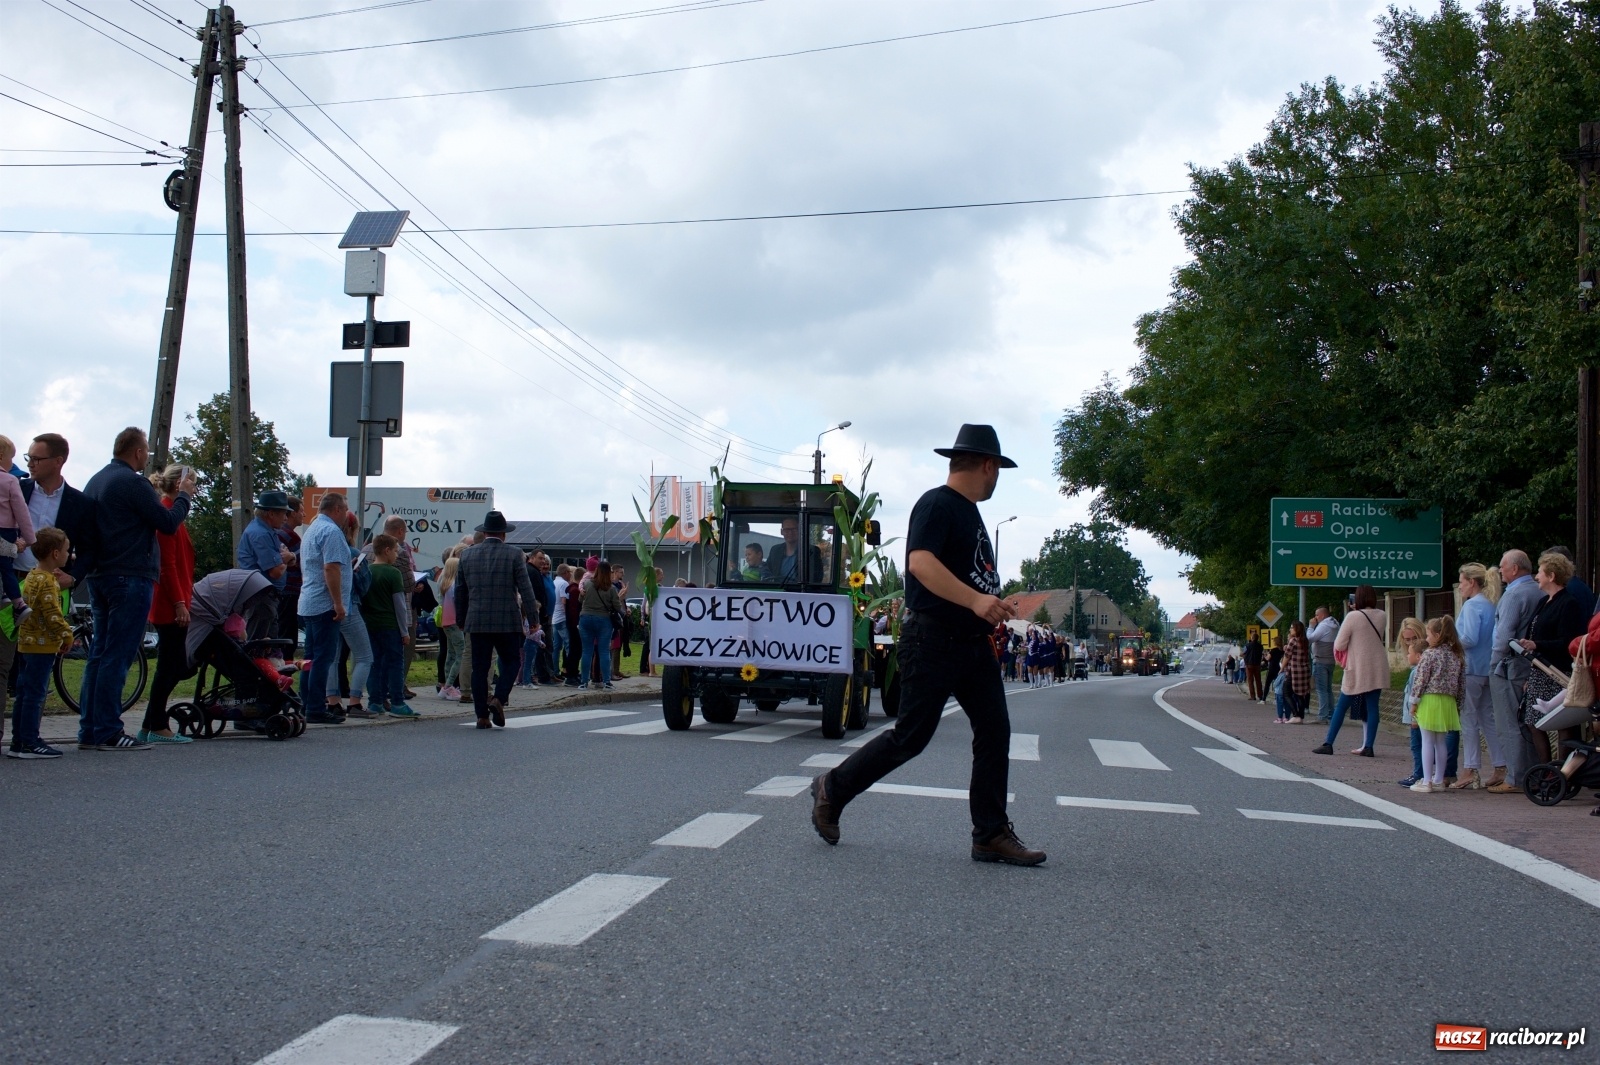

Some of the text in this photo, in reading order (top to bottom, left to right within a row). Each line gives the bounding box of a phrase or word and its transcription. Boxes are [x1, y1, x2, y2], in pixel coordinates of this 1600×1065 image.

[442, 489, 488, 501] Oleo-Mac
[391, 506, 428, 517] Witamy
[1331, 502, 1393, 517] Racibó
[404, 518, 466, 533] ROSAT
[1301, 514, 1317, 525] 45
[1330, 521, 1380, 538] Opole
[1333, 546, 1414, 560] Owsiszcze
[1300, 566, 1323, 577] 936
[1333, 565, 1420, 580] Wodzisław
[663, 595, 836, 628] SOŁECTWO
[658, 635, 842, 664] KRZYŻANOWICE
